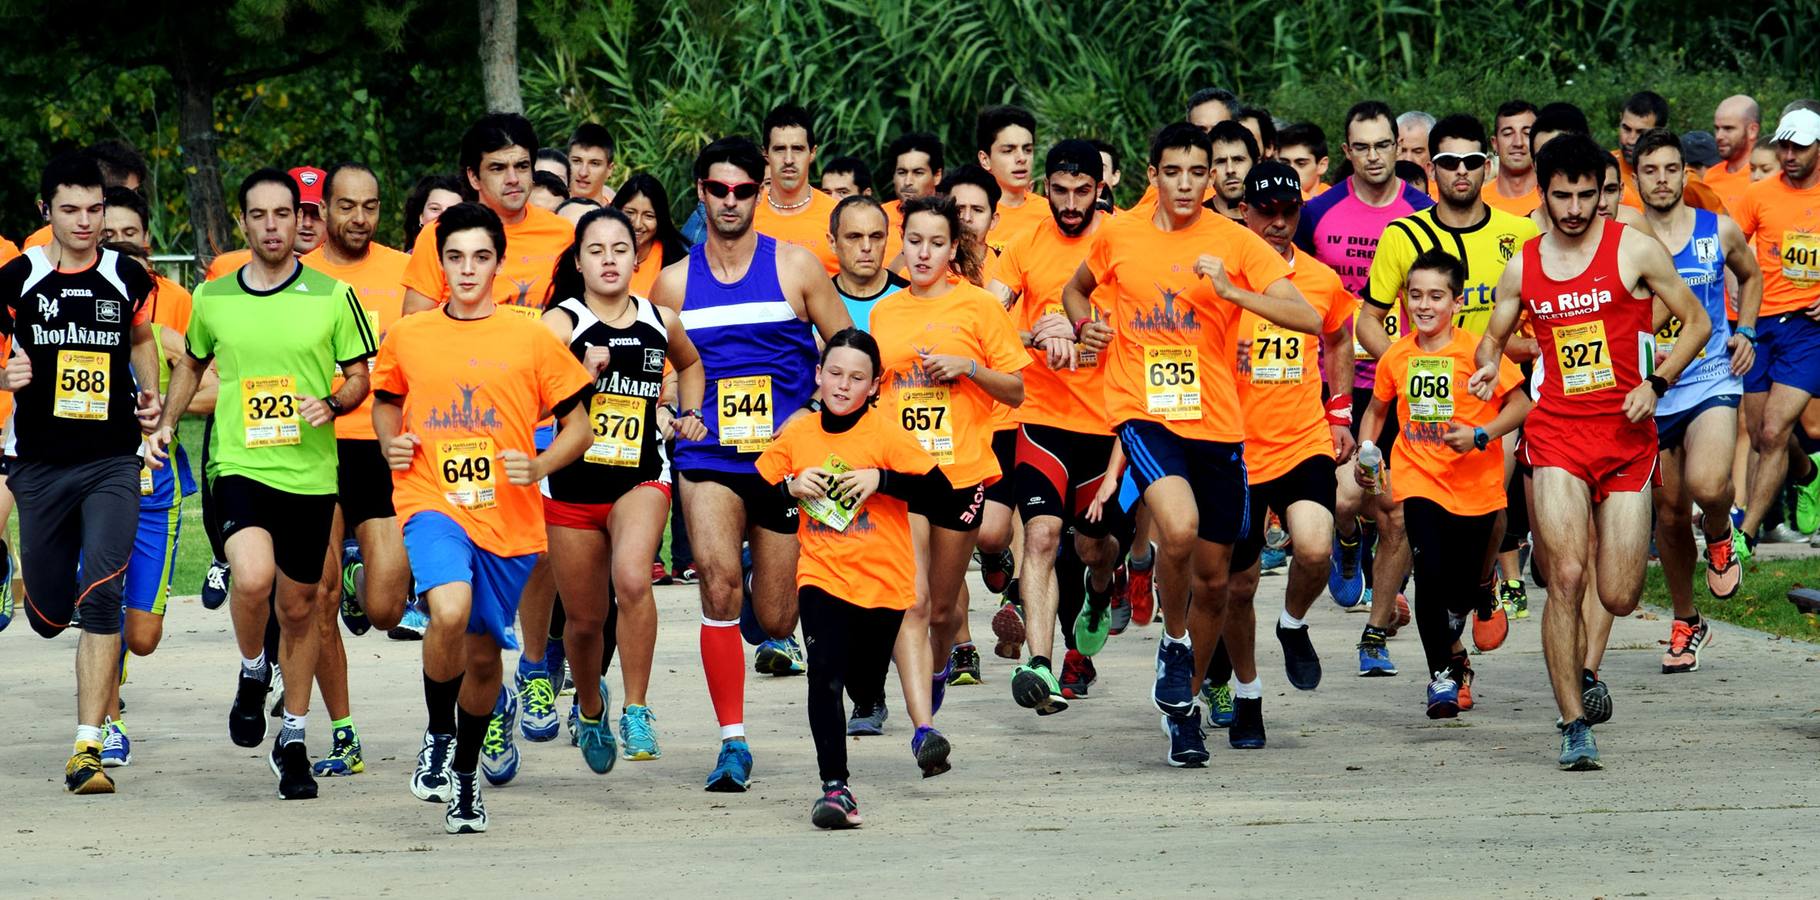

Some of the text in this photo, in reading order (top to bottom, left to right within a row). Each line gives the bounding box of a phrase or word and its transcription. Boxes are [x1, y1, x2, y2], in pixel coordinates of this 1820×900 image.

[1346, 248, 1376, 259] CRO
[1348, 236, 1379, 247] DUA
[1784, 246, 1817, 267] 401
[1529, 287, 1612, 314] La Rioja
[1256, 337, 1299, 360] 713
[1561, 340, 1603, 369] 327
[61, 368, 105, 393] 588
[1149, 362, 1195, 386] 635
[1410, 375, 1449, 399] 058
[248, 394, 294, 420] 323
[722, 393, 768, 418] 544
[592, 413, 640, 441] 370
[902, 406, 946, 431] 657
[443, 456, 490, 484] 649
